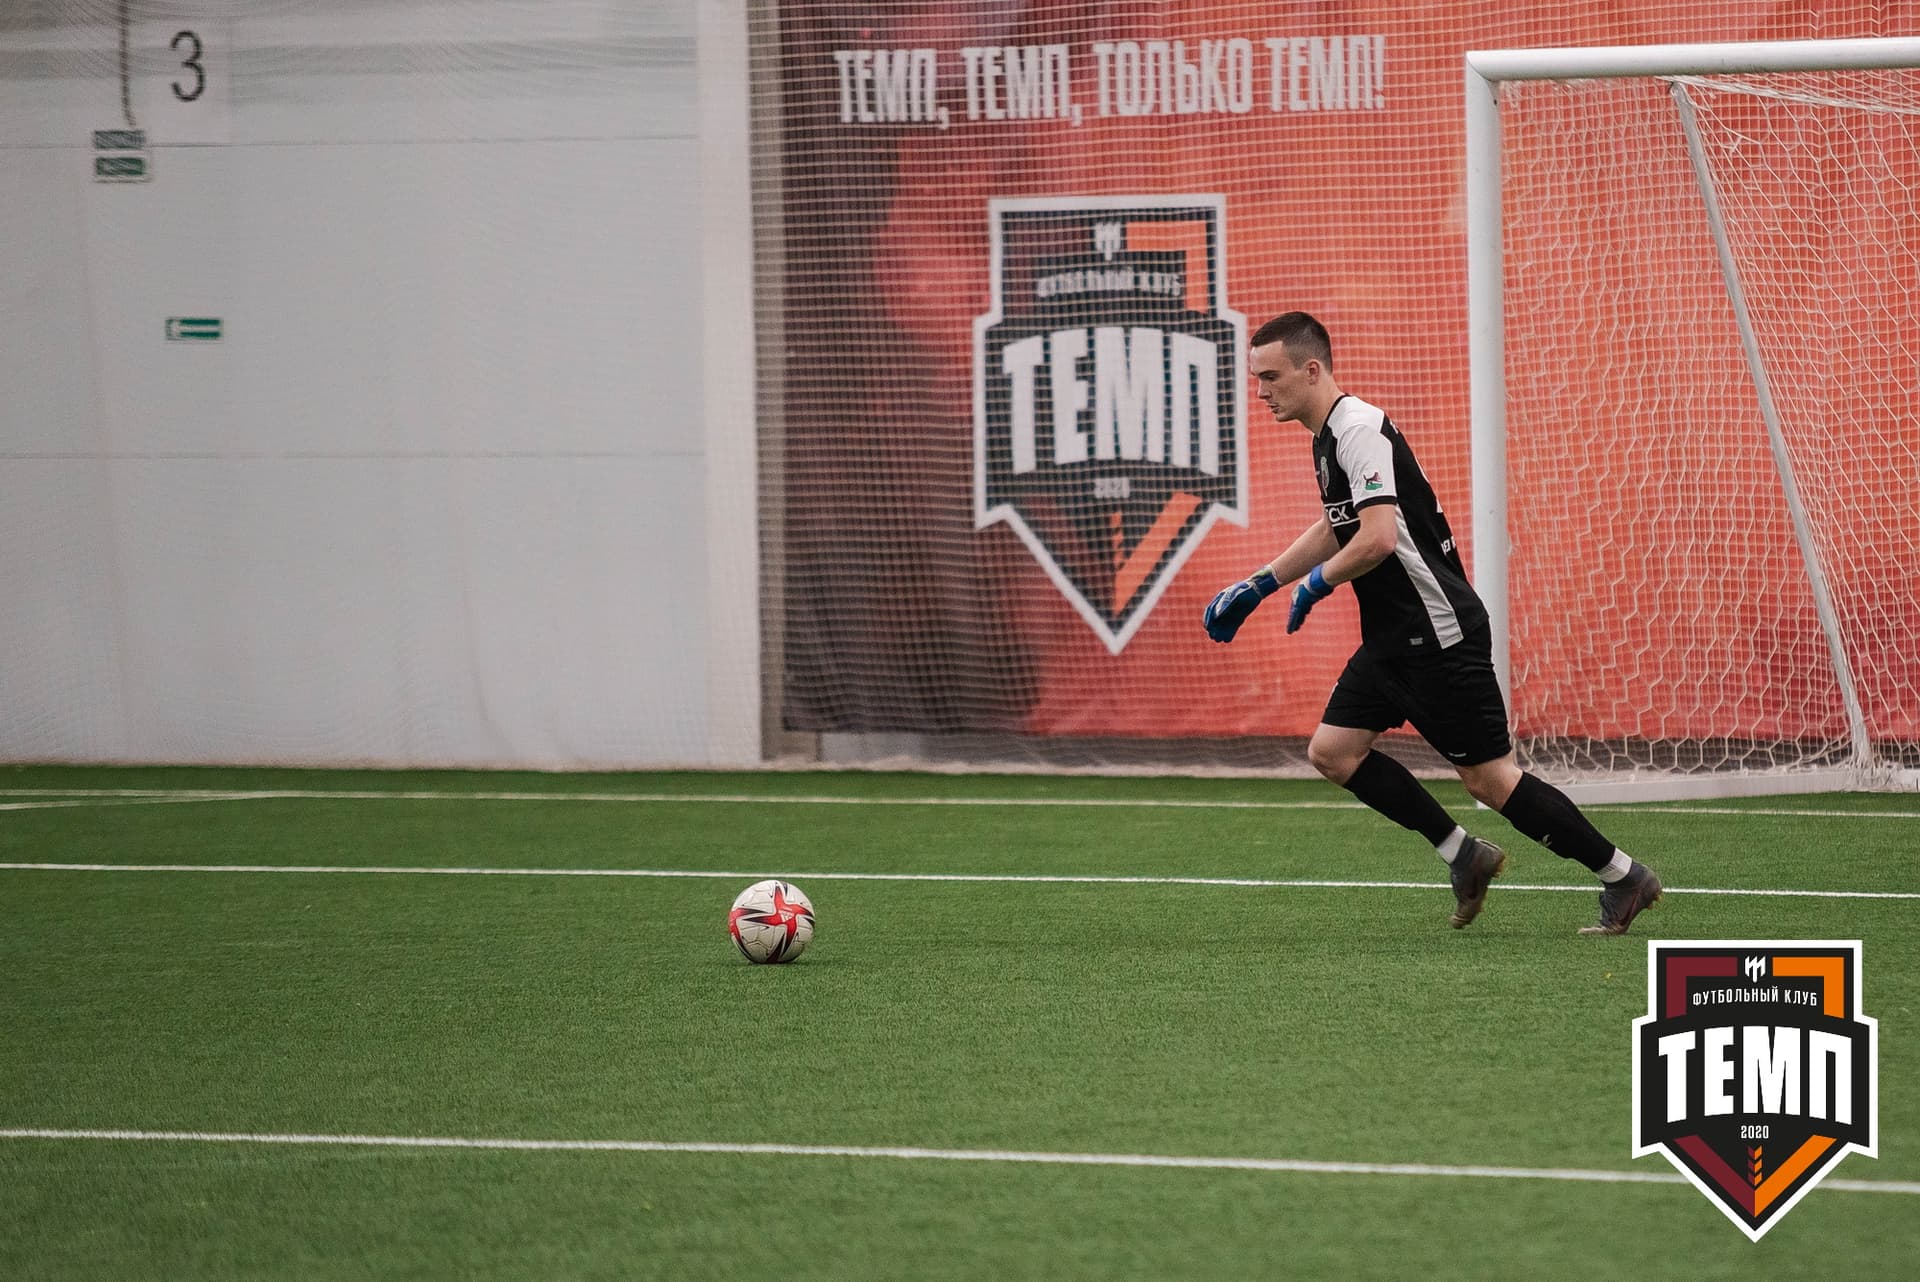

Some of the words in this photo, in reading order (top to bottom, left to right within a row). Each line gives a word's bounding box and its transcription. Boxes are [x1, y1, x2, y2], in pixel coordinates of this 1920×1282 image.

[170, 30, 205, 102] 3
[834, 49, 948, 128] ТЕМП,
[961, 44, 1083, 126] ТЕМП,
[1093, 37, 1254, 117] ТОЛЬКО
[1263, 34, 1386, 110] ТЕМП!
[1002, 326, 1218, 477] ТЕМП
